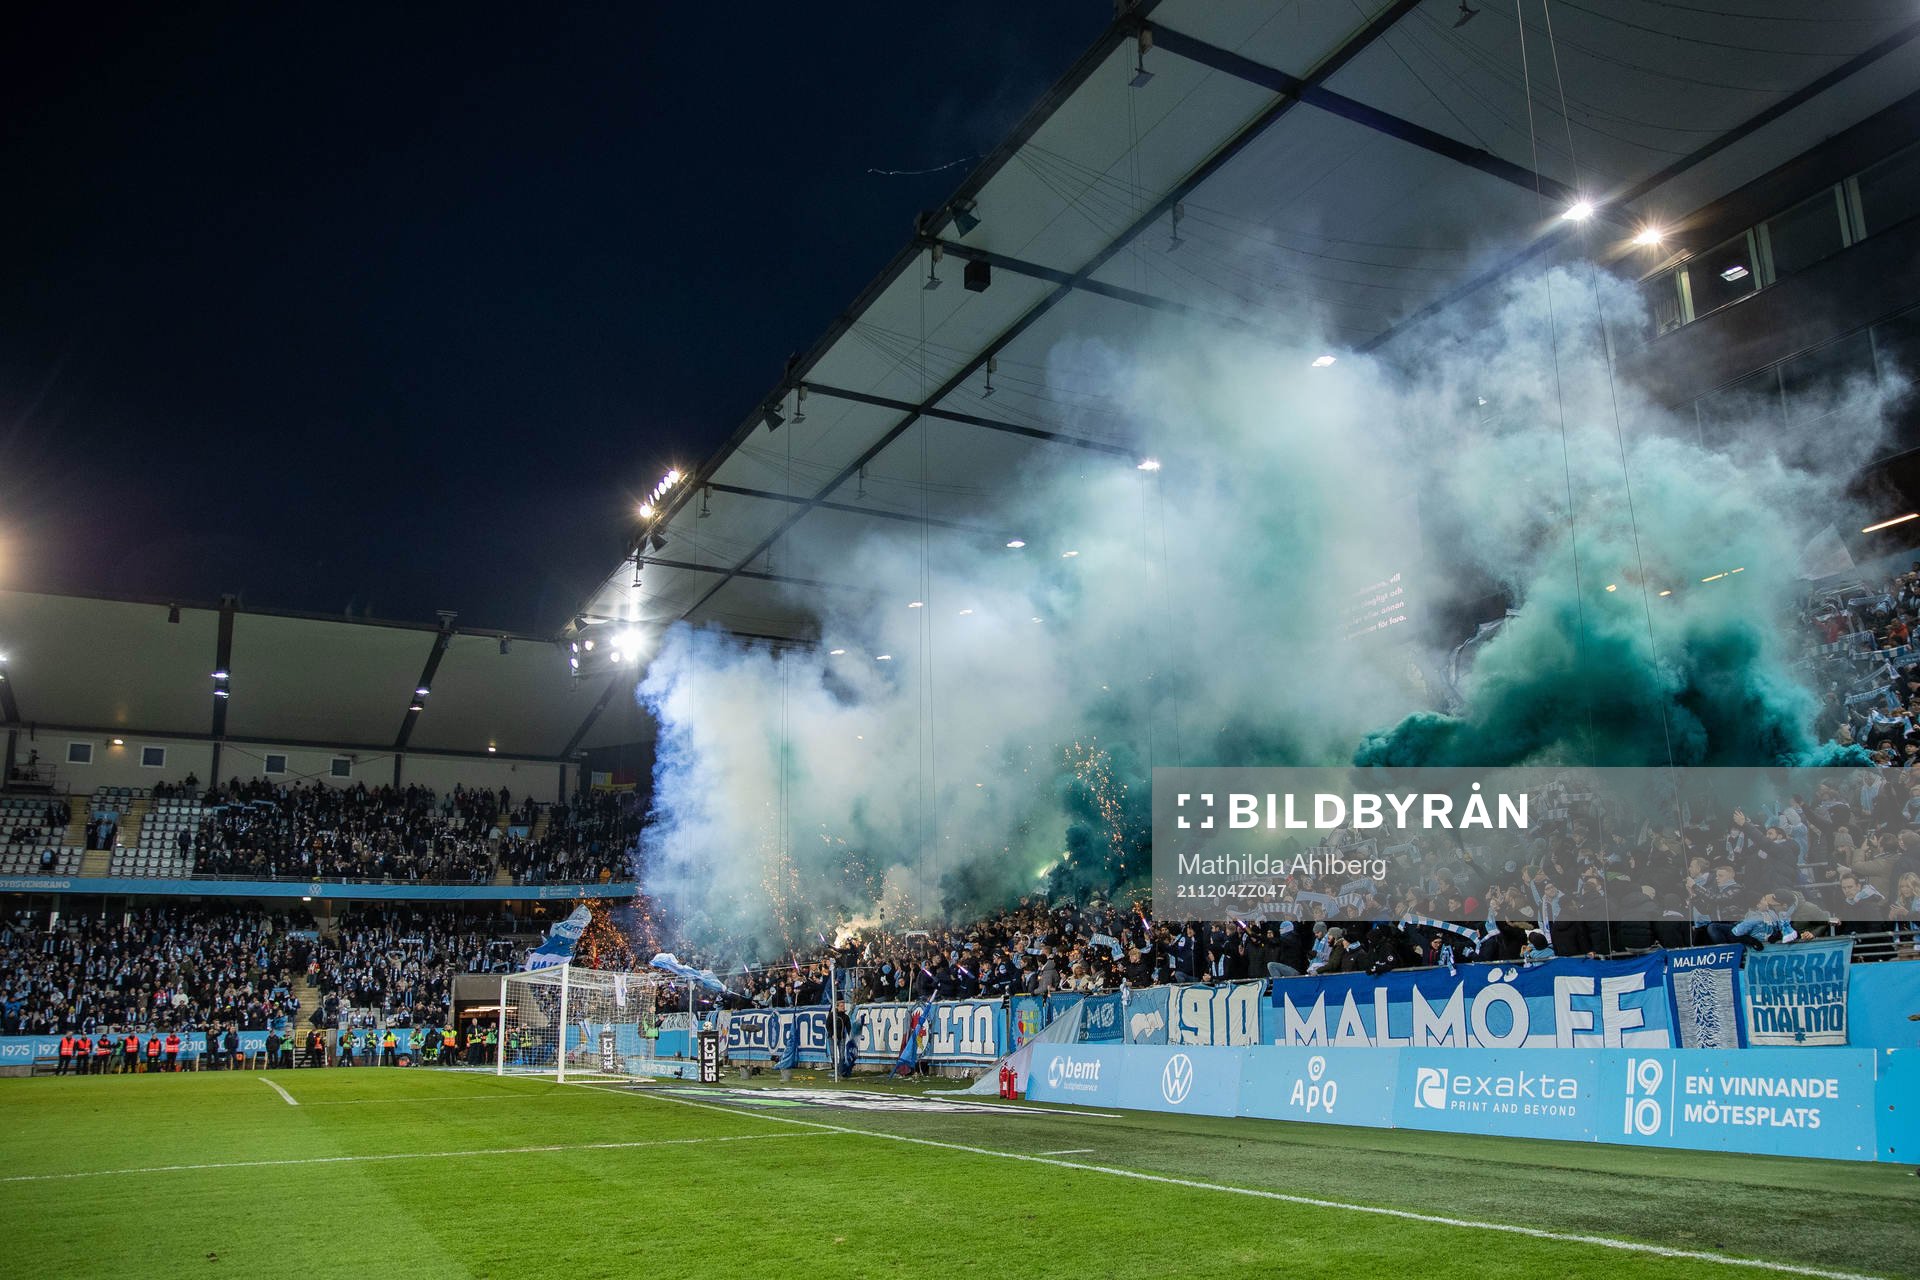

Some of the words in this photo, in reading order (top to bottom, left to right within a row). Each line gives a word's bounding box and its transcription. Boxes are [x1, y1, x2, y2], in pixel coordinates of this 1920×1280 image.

[1673, 952, 1717, 968] MALMÖ
[1719, 951, 1735, 963] FF
[1748, 950, 1844, 985] NORRA
[1284, 968, 1530, 1048] MALMÖ
[1553, 972, 1646, 1048] FF
[2, 1044, 30, 1056] 1975
[38, 1044, 57, 1055] 197
[703, 1037, 717, 1082] SELECT
[1065, 1056, 1101, 1080] bemt
[1626, 1057, 1664, 1096] 19
[1290, 1079, 1338, 1114] ApQ
[1452, 1070, 1578, 1099] exakta
[1685, 1076, 1714, 1095] EN
[1720, 1077, 1839, 1099] VINNANDE
[1451, 1100, 1487, 1112] PRINT
[1493, 1103, 1518, 1114] AND
[1524, 1104, 1576, 1116] BEYOND
[1624, 1097, 1662, 1136] 10
[1684, 1100, 1821, 1129] MÖTESPLATS
